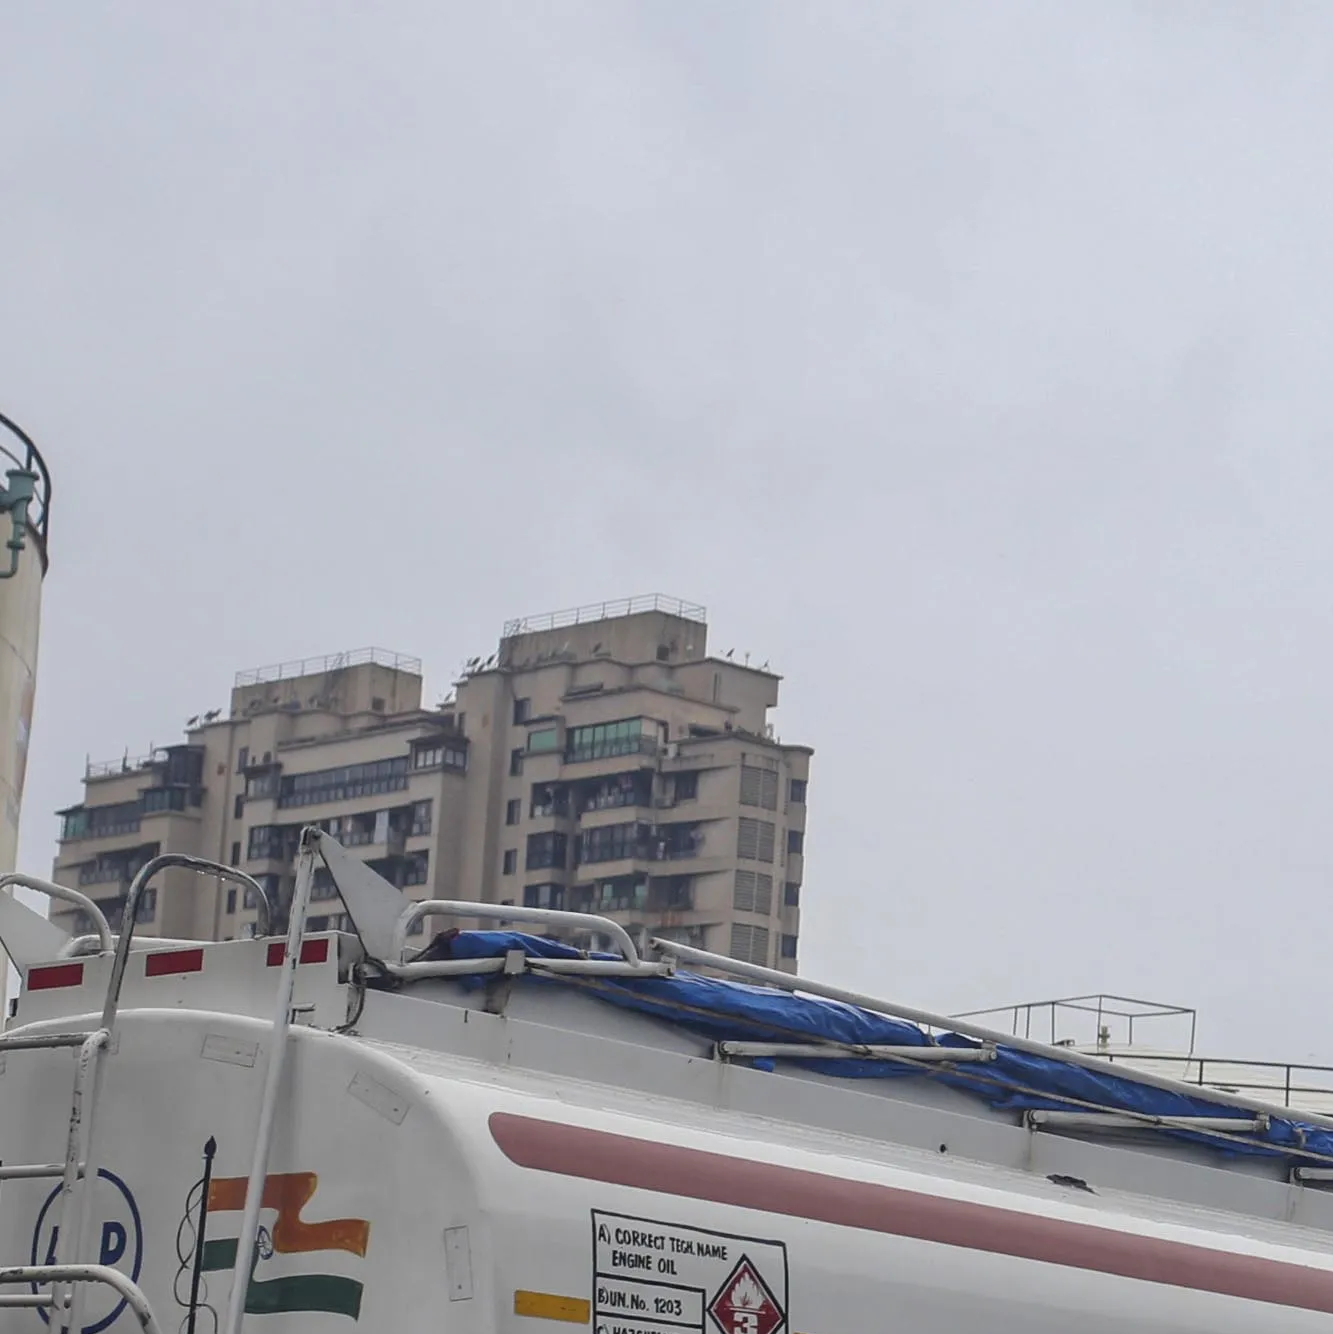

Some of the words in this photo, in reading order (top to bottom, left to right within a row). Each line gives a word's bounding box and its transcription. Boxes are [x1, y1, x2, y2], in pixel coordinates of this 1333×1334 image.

[615, 1228, 666, 1251] CORRECT
[697, 1242, 728, 1261] NAME
[612, 1250, 652, 1271] ENGINE
[657, 1258, 678, 1276] OIL
[654, 1297, 682, 1316] 1203
